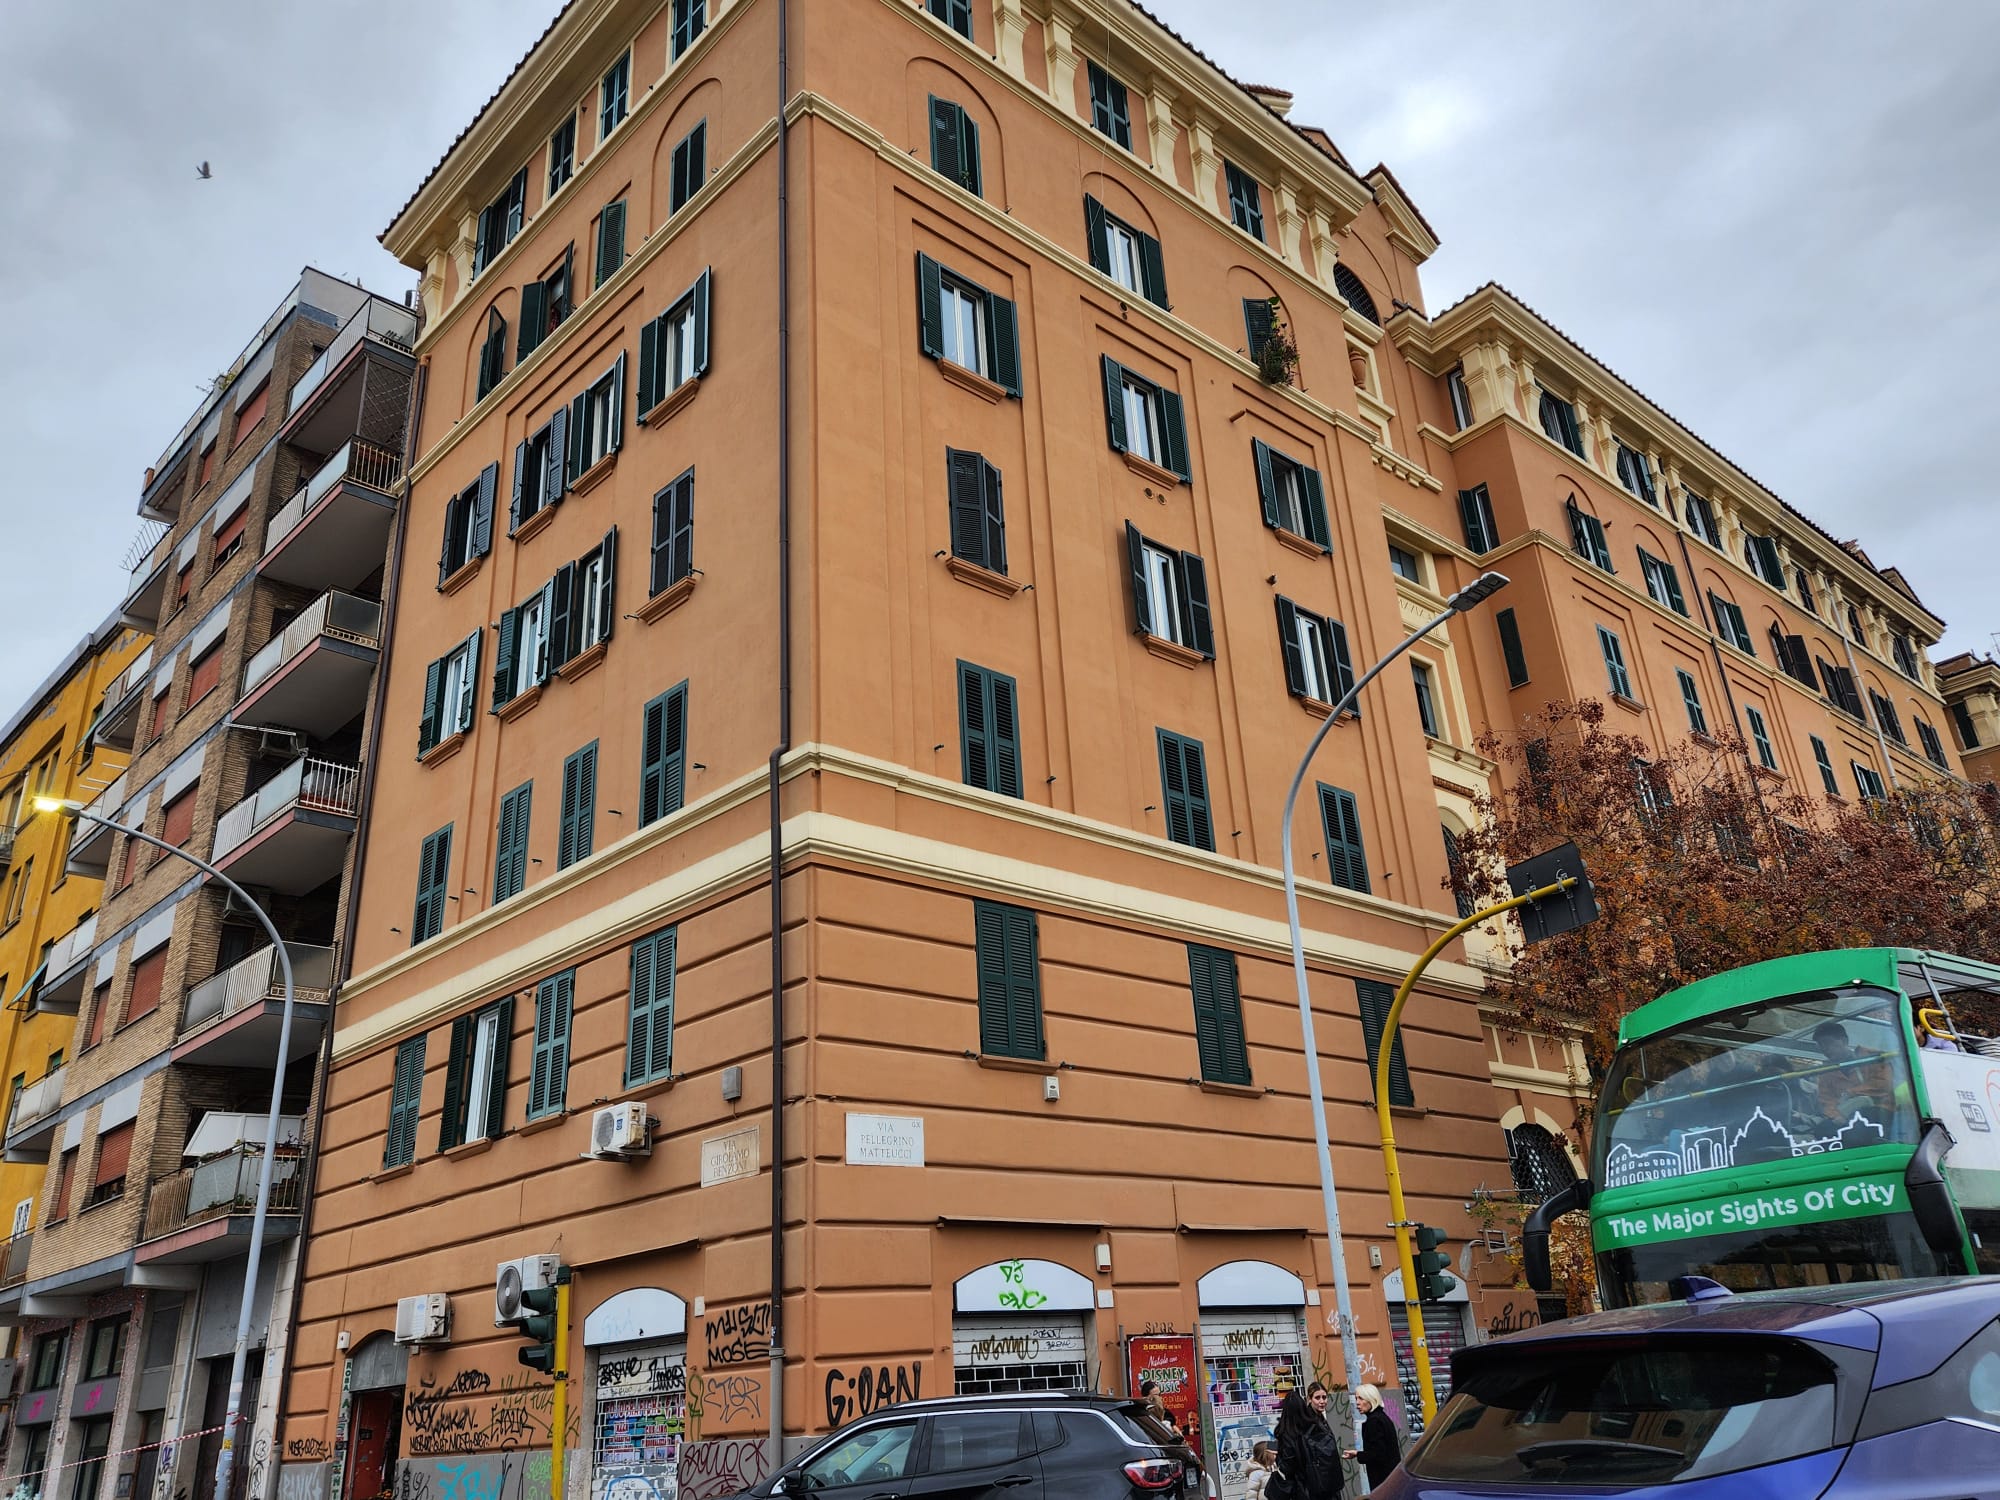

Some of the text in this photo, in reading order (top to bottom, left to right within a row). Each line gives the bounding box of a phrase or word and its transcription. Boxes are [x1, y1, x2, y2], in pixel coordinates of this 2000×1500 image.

[877, 1121, 894, 1133] VIA
[723, 1139, 737, 1151] VIA
[860, 1134, 914, 1147] PELLEGRINO
[710, 1148, 750, 1167] GIROLAMO
[860, 1146, 912, 1160] MATTEUCCI
[713, 1159, 747, 1177] BENZONI
[1608, 1182, 1896, 1238] The Major Sights Of City
[1145, 1321, 1175, 1334] SPQR
[1141, 1367, 1186, 1382] DISNEY
